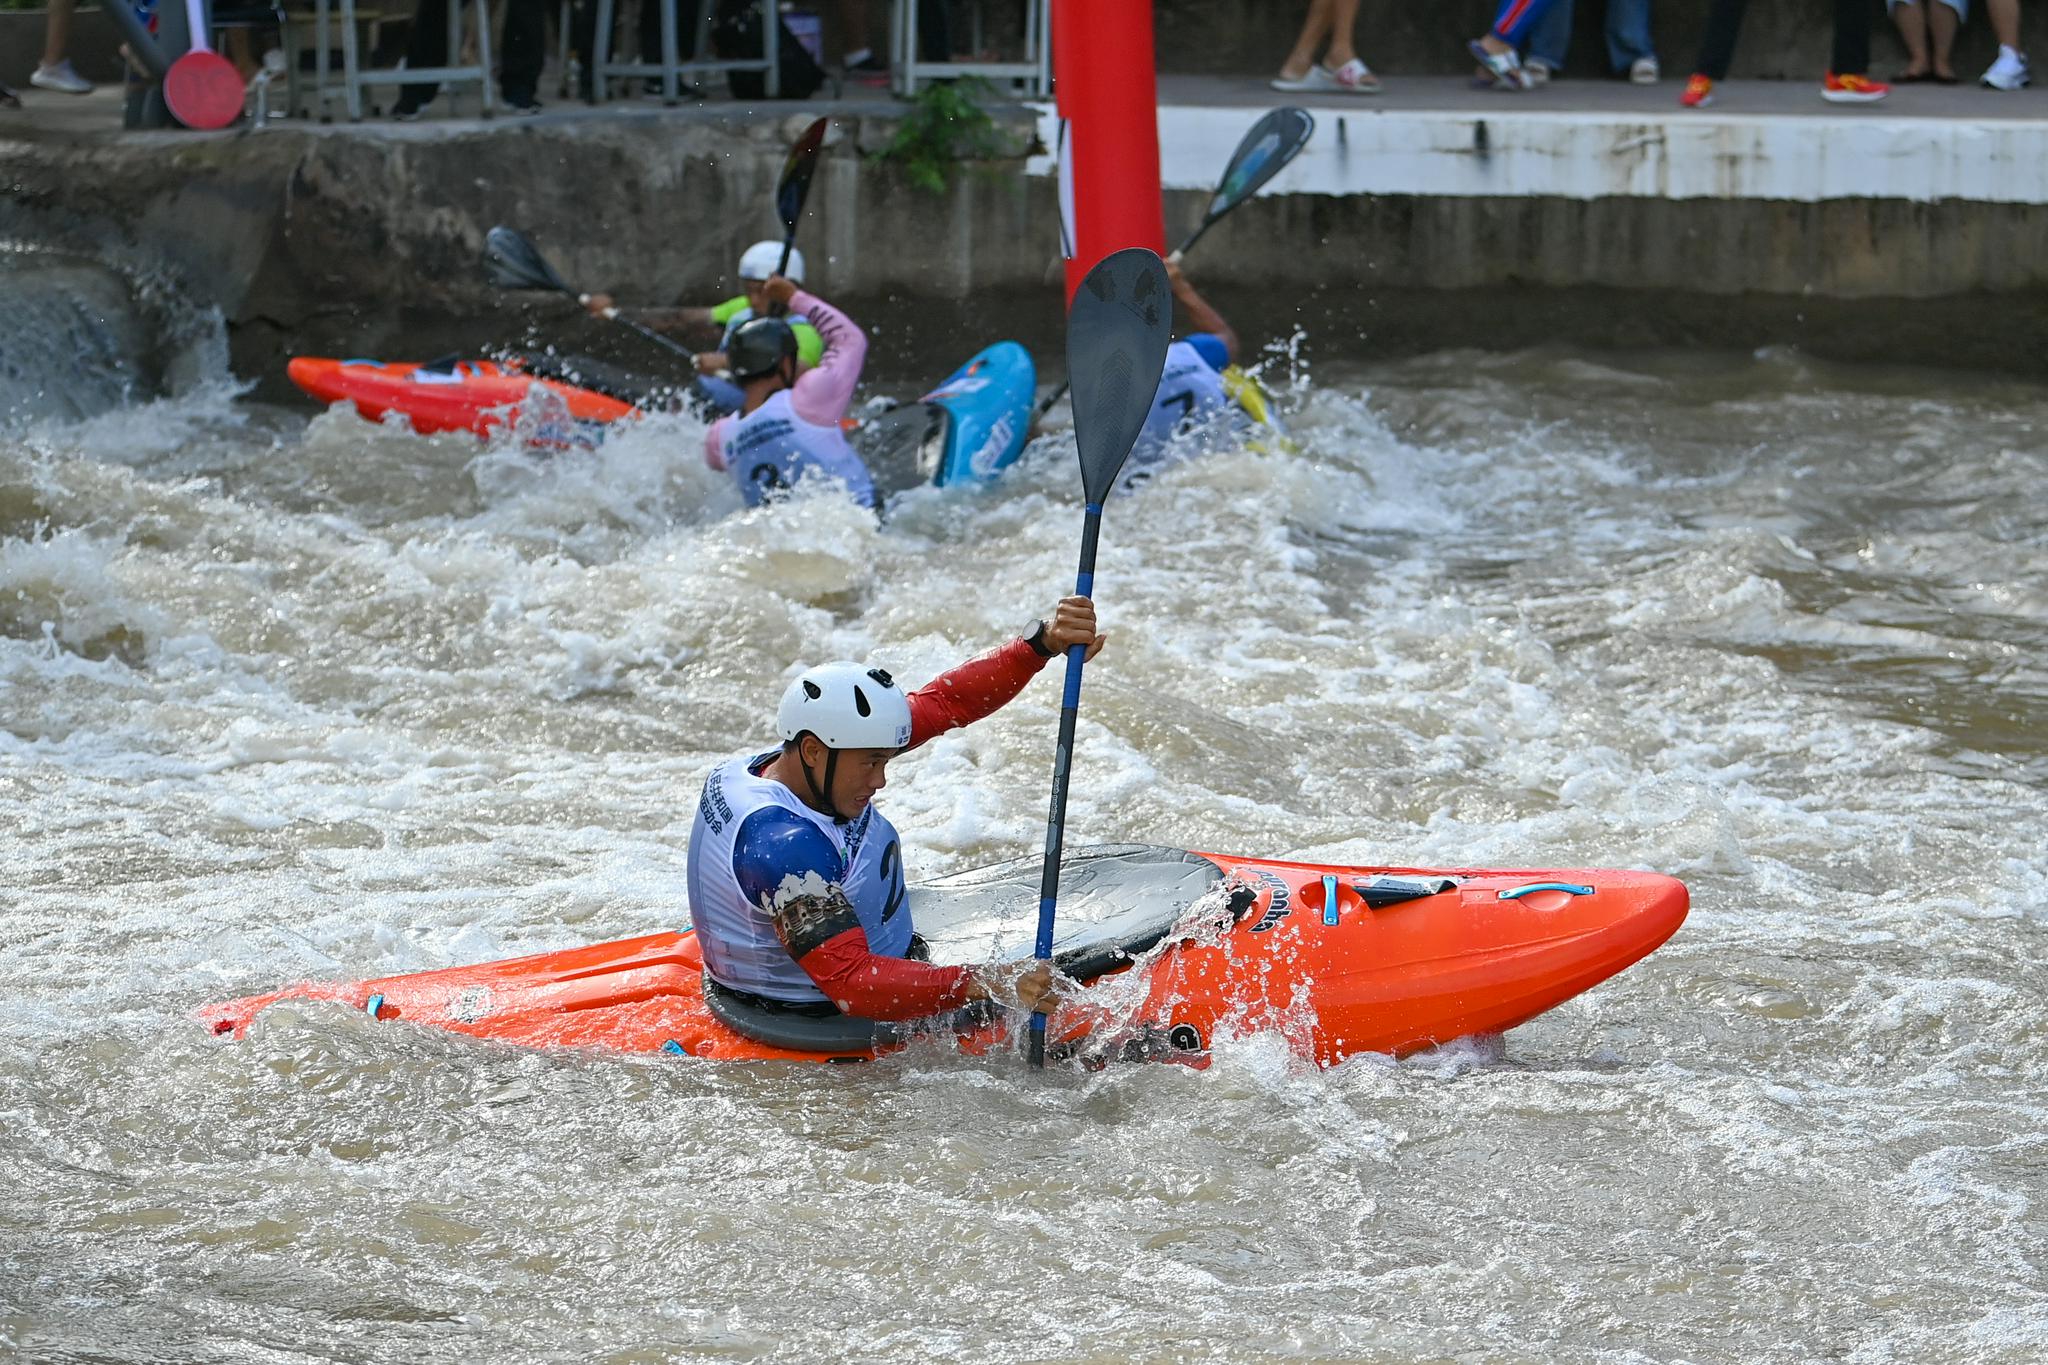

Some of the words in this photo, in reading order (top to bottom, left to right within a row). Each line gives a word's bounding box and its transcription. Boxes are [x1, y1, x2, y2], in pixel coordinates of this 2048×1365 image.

[709, 760, 734, 825] 人民共和国
